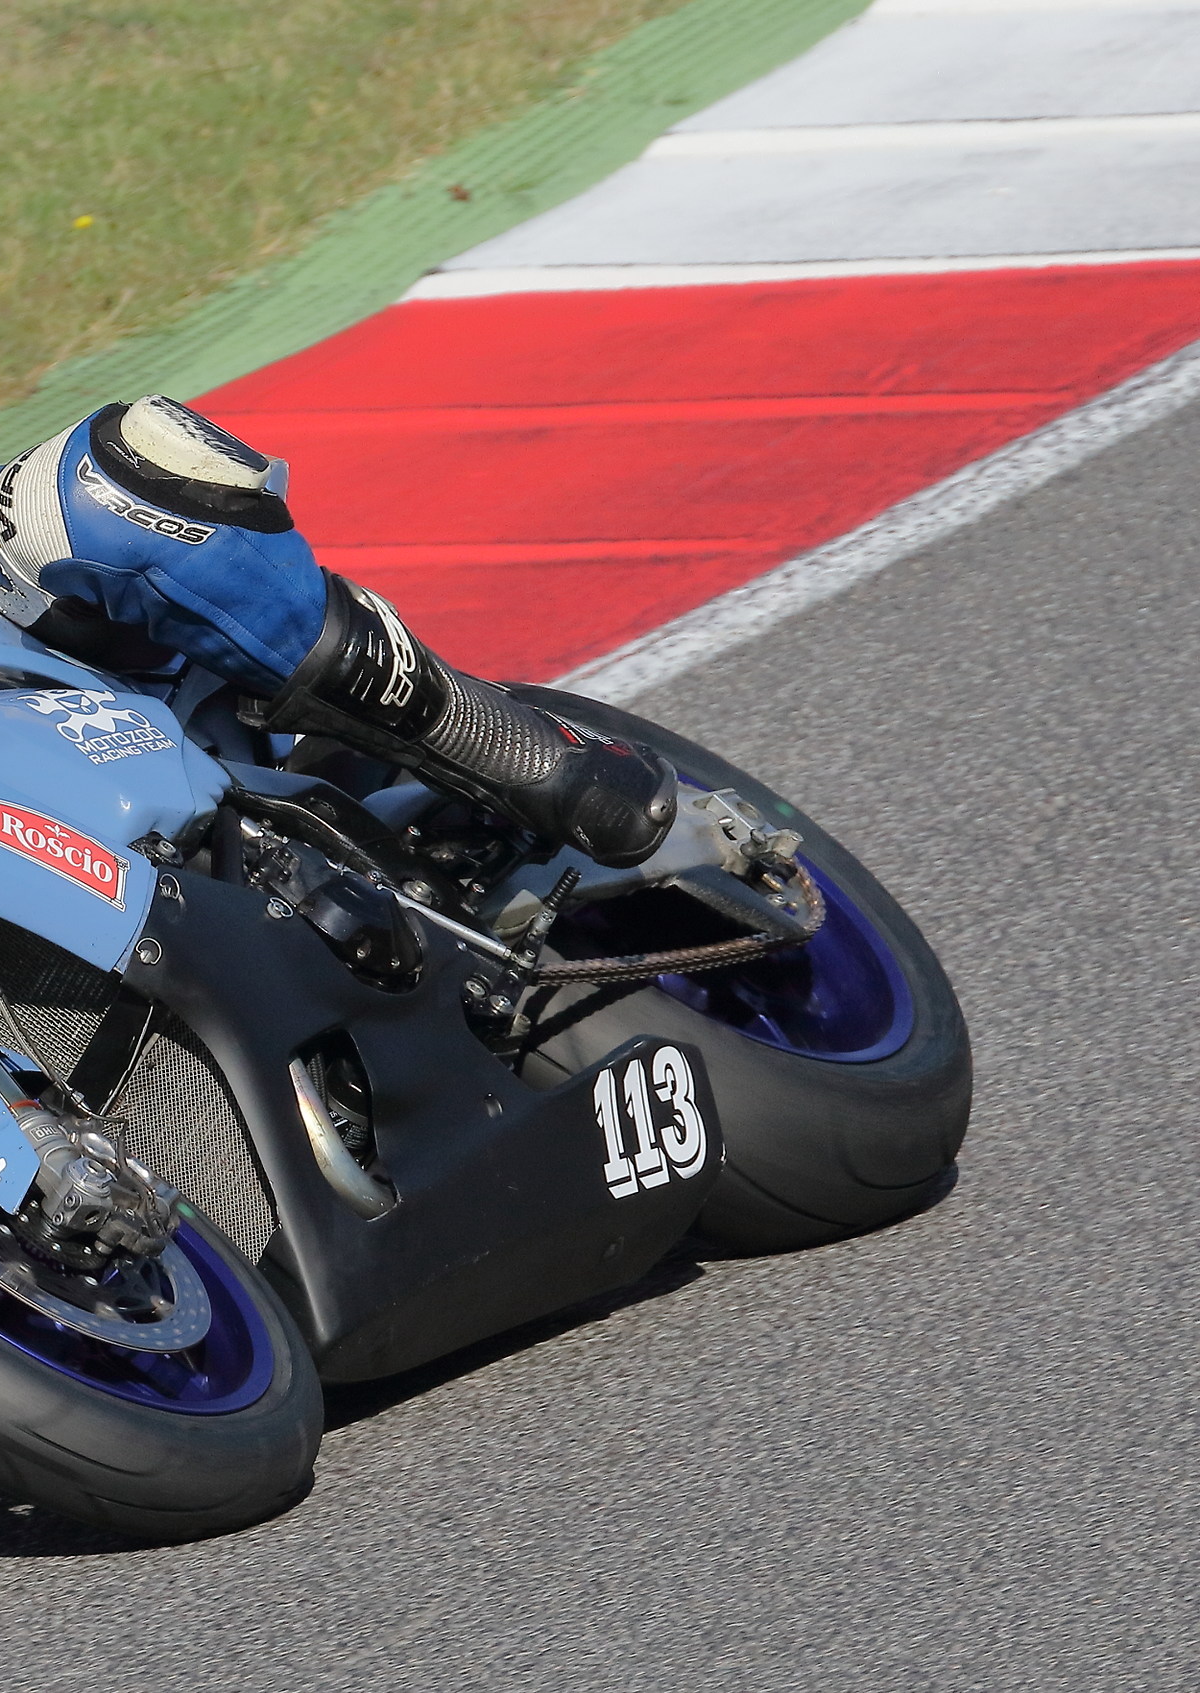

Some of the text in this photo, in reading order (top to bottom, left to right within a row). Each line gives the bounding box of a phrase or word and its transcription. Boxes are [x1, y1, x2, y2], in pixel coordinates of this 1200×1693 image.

[74, 727, 166, 755] MOTOZOO
[88, 739, 178, 766] RACING TEAM
[592, 1045, 708, 1200] 113
